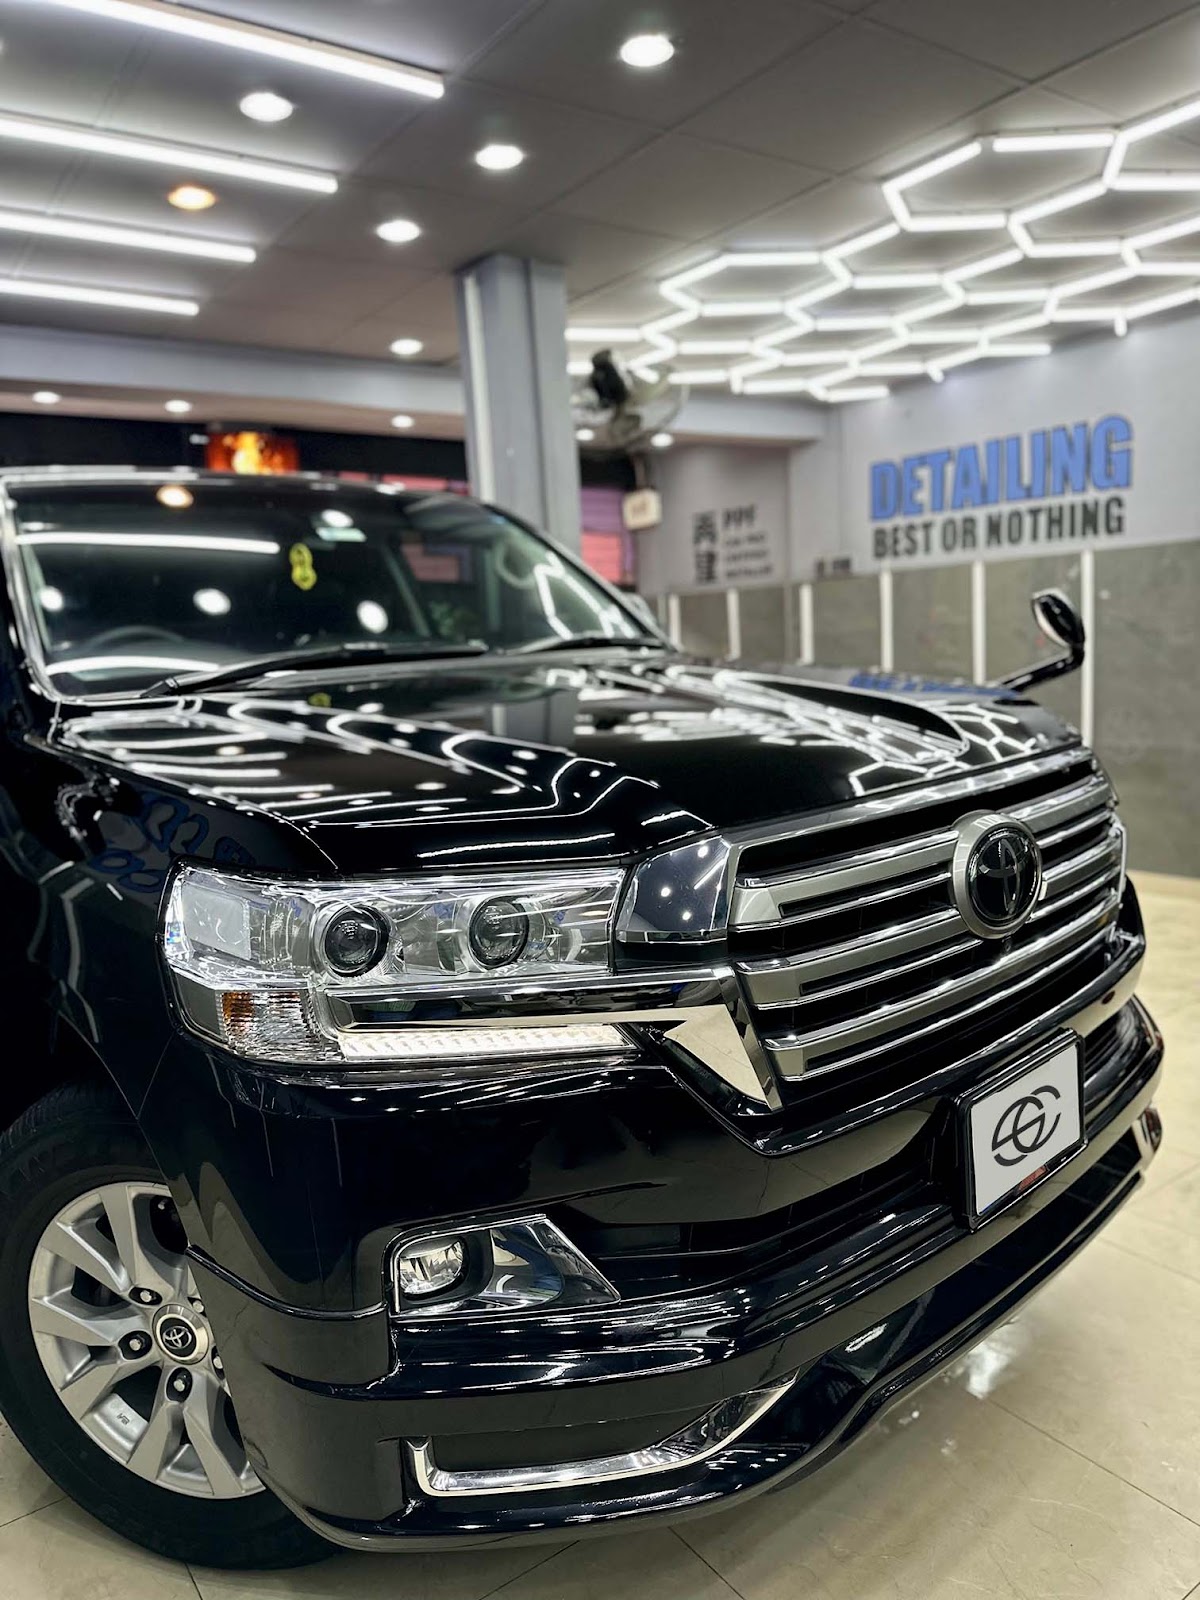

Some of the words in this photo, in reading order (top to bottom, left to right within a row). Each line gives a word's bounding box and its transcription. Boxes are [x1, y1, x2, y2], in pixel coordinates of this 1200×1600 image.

[870, 414, 1133, 520] DETAILING
[874, 520, 933, 559] BEST
[941, 516, 977, 551] OR
[986, 497, 1125, 547] NOTHING
